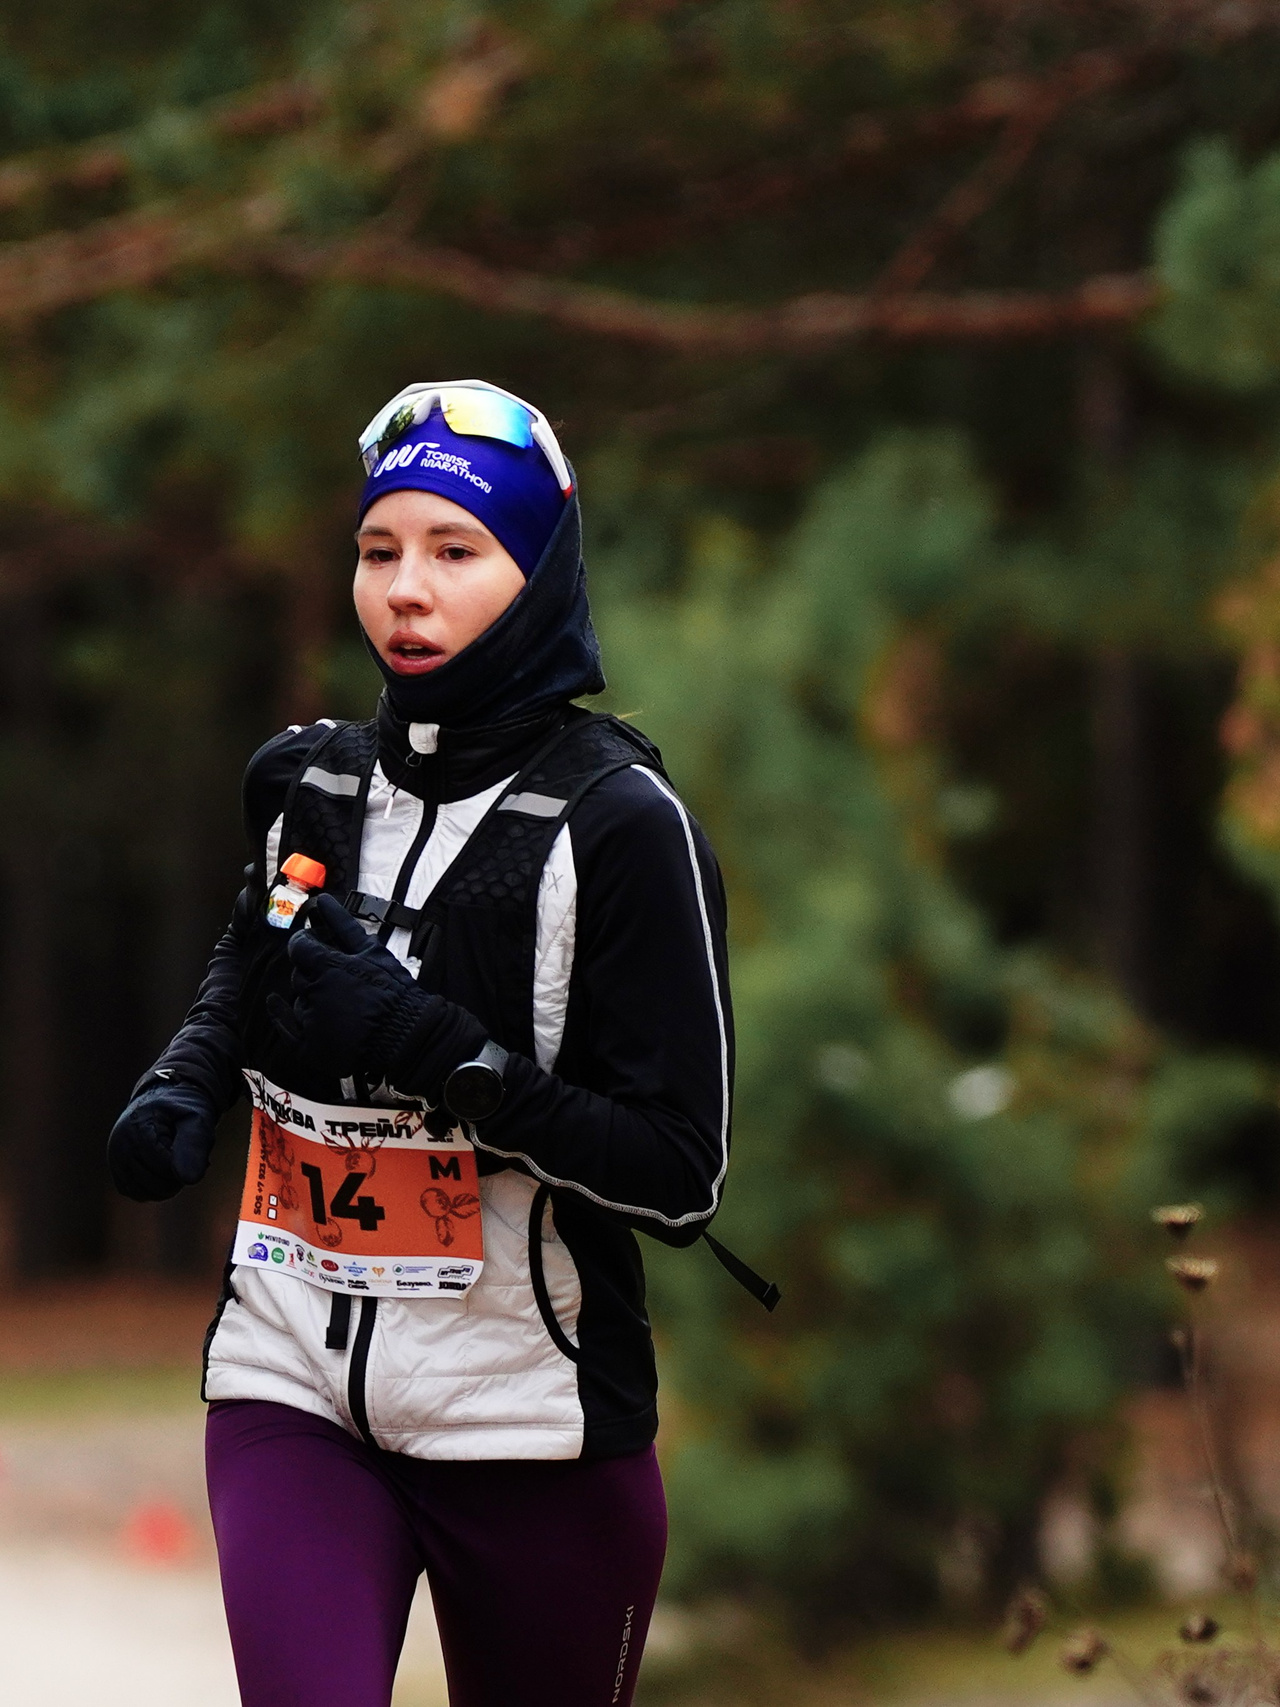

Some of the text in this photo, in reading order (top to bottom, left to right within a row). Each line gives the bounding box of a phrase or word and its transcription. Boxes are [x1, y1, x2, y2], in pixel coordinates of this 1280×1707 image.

[425, 450, 471, 469] TOMSK
[420, 458, 493, 494] MARATHON
[325, 1118, 412, 1139] ТРЕЙЛ
[258, 1163, 266, 1180] 923
[257, 1181, 264, 1193] +7
[301, 1162, 386, 1231] 14
[253, 1195, 263, 1216] SOS
[612, 1605, 634, 1704] NORDSKI
